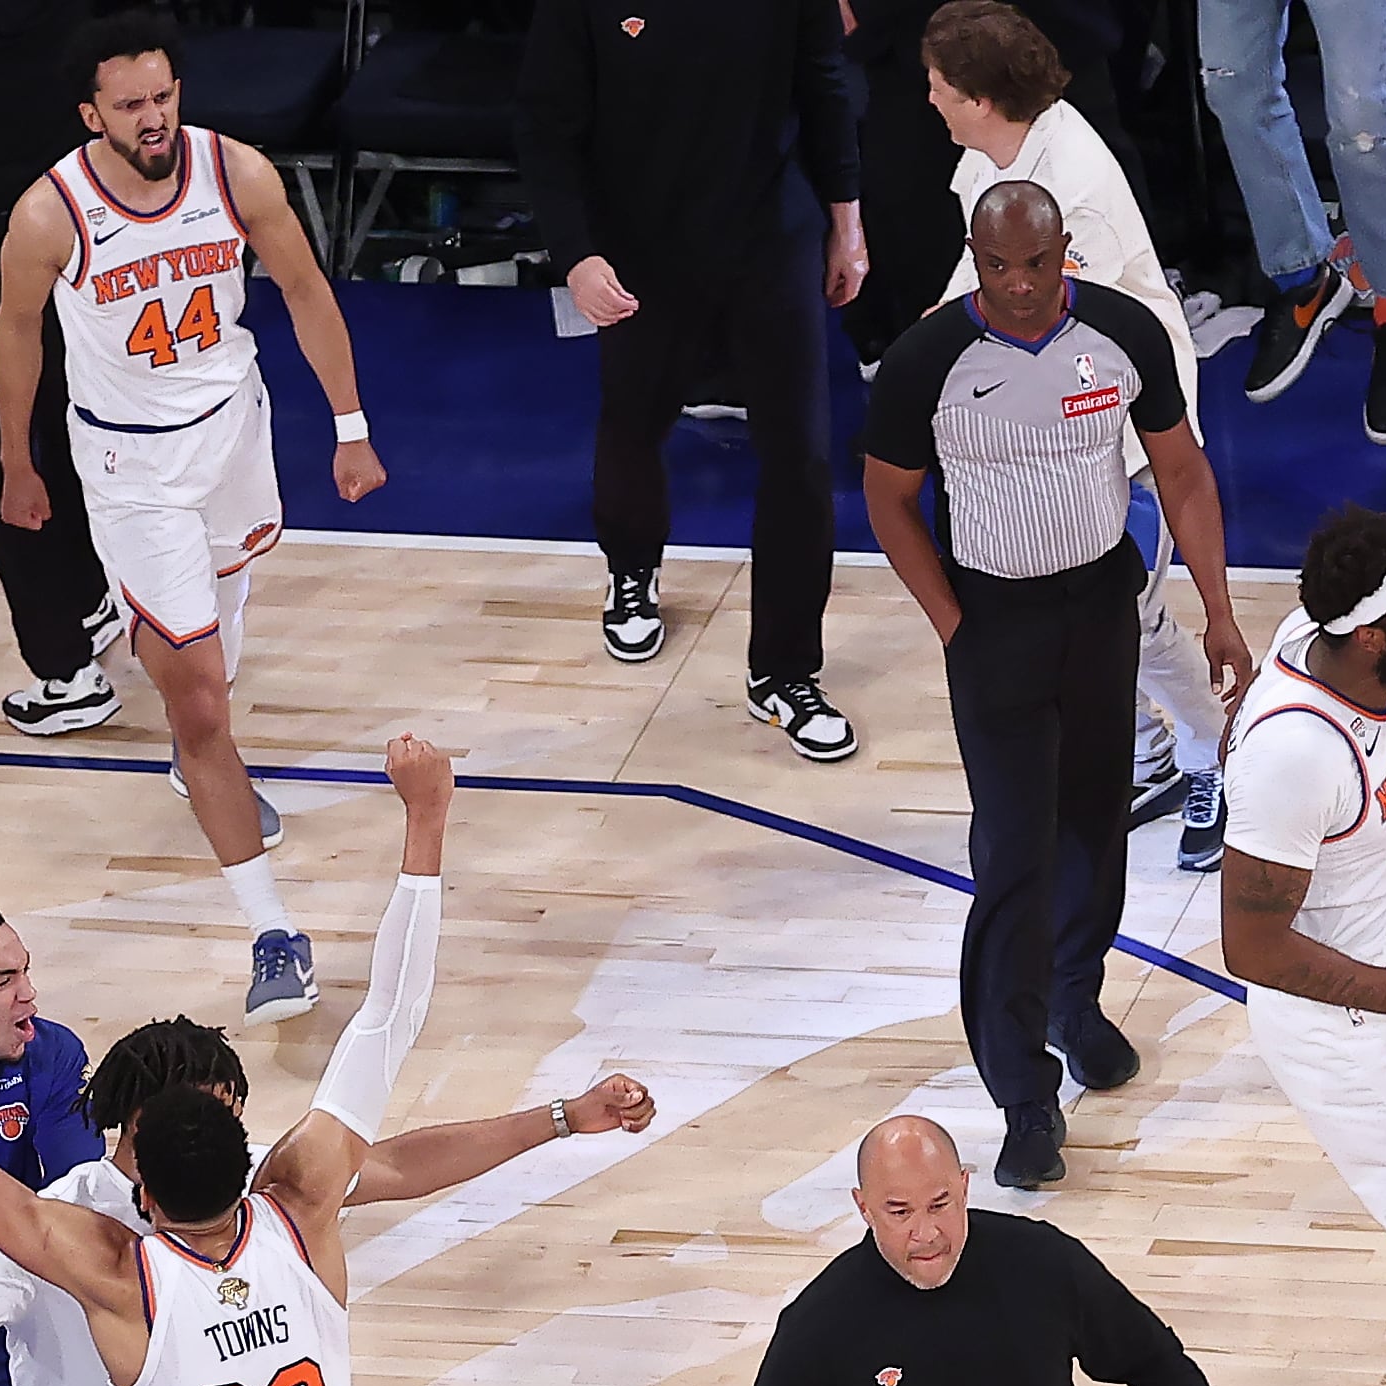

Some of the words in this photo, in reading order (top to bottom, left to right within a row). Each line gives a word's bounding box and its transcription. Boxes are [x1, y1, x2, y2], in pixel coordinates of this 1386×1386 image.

[91, 255, 160, 305] NEW
[165, 238, 240, 281] YORK
[125, 284, 221, 369] 44
[1064, 391, 1120, 415] Emirates
[204, 1304, 290, 1363] TOWNS
